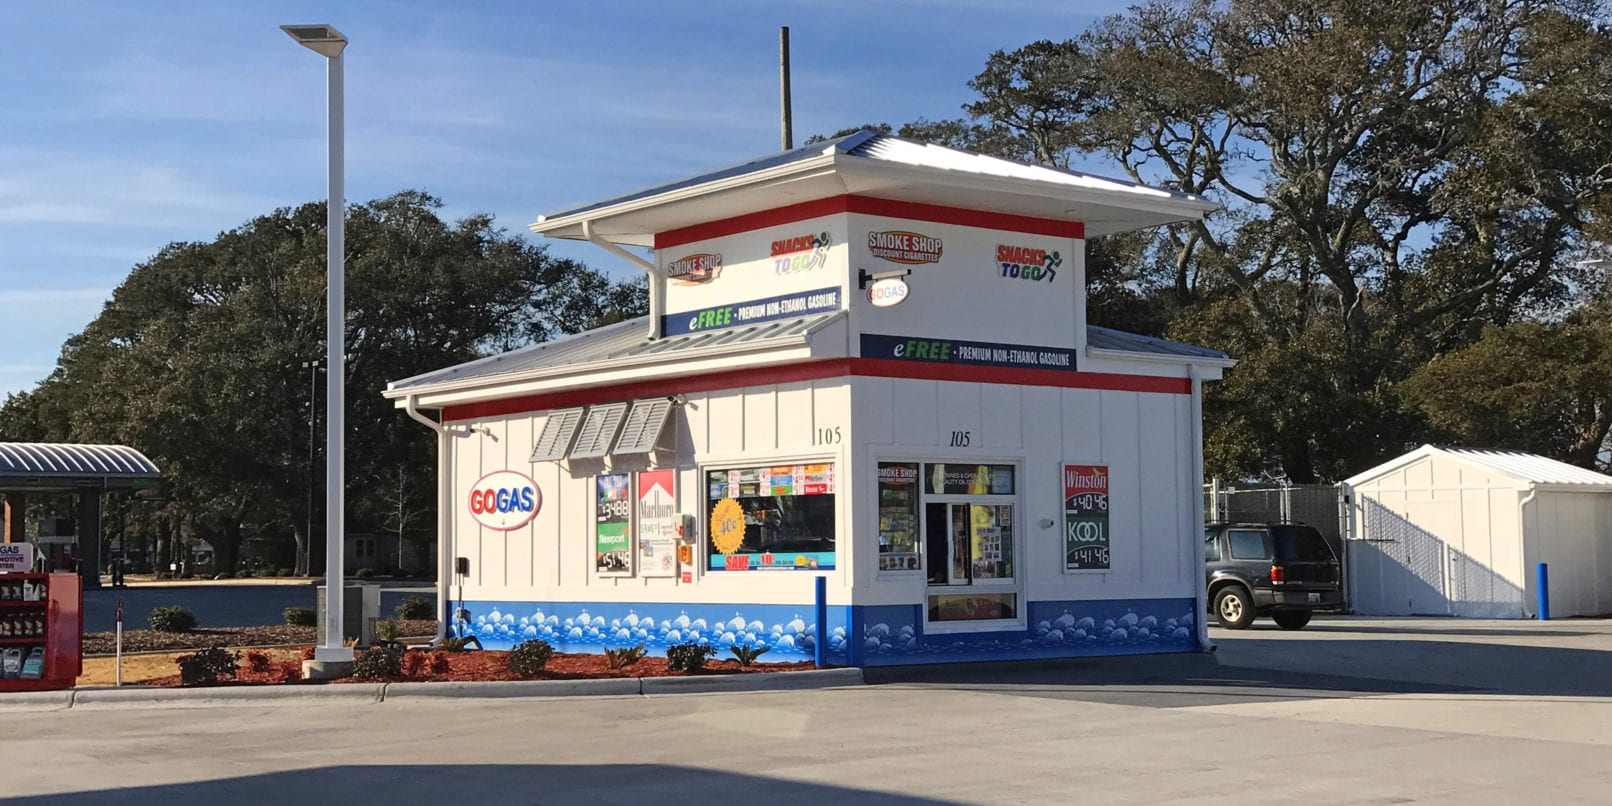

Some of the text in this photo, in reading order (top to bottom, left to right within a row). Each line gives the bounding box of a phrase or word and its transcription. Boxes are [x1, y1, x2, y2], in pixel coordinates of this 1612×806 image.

[771, 234, 815, 257] SNACKS
[869, 232, 942, 253] SMOKE SHOP
[775, 254, 810, 273] TO GO
[873, 248, 939, 262] DISCOUNT CIGARETTES
[997, 244, 1047, 266] SNACKS
[668, 258, 697, 277] SMOKE
[698, 254, 721, 271] SHOP
[1002, 263, 1041, 281] TO GO
[688, 292, 837, 331] eFREE PREMIUM NON-ETHANOL GASOLINE
[893, 340, 1070, 367] eFREE PREMIUM NON-ETHANOL GASOLINE
[818, 426, 842, 446] 105
[949, 430, 971, 448] 105
[900, 469, 917, 478] SHOP
[1066, 470, 1106, 489] Winston
[470, 487, 534, 515] GOGAS
[598, 534, 625, 545] Newport
[1068, 521, 1106, 542] KOOL
[725, 555, 750, 570] SAVE
